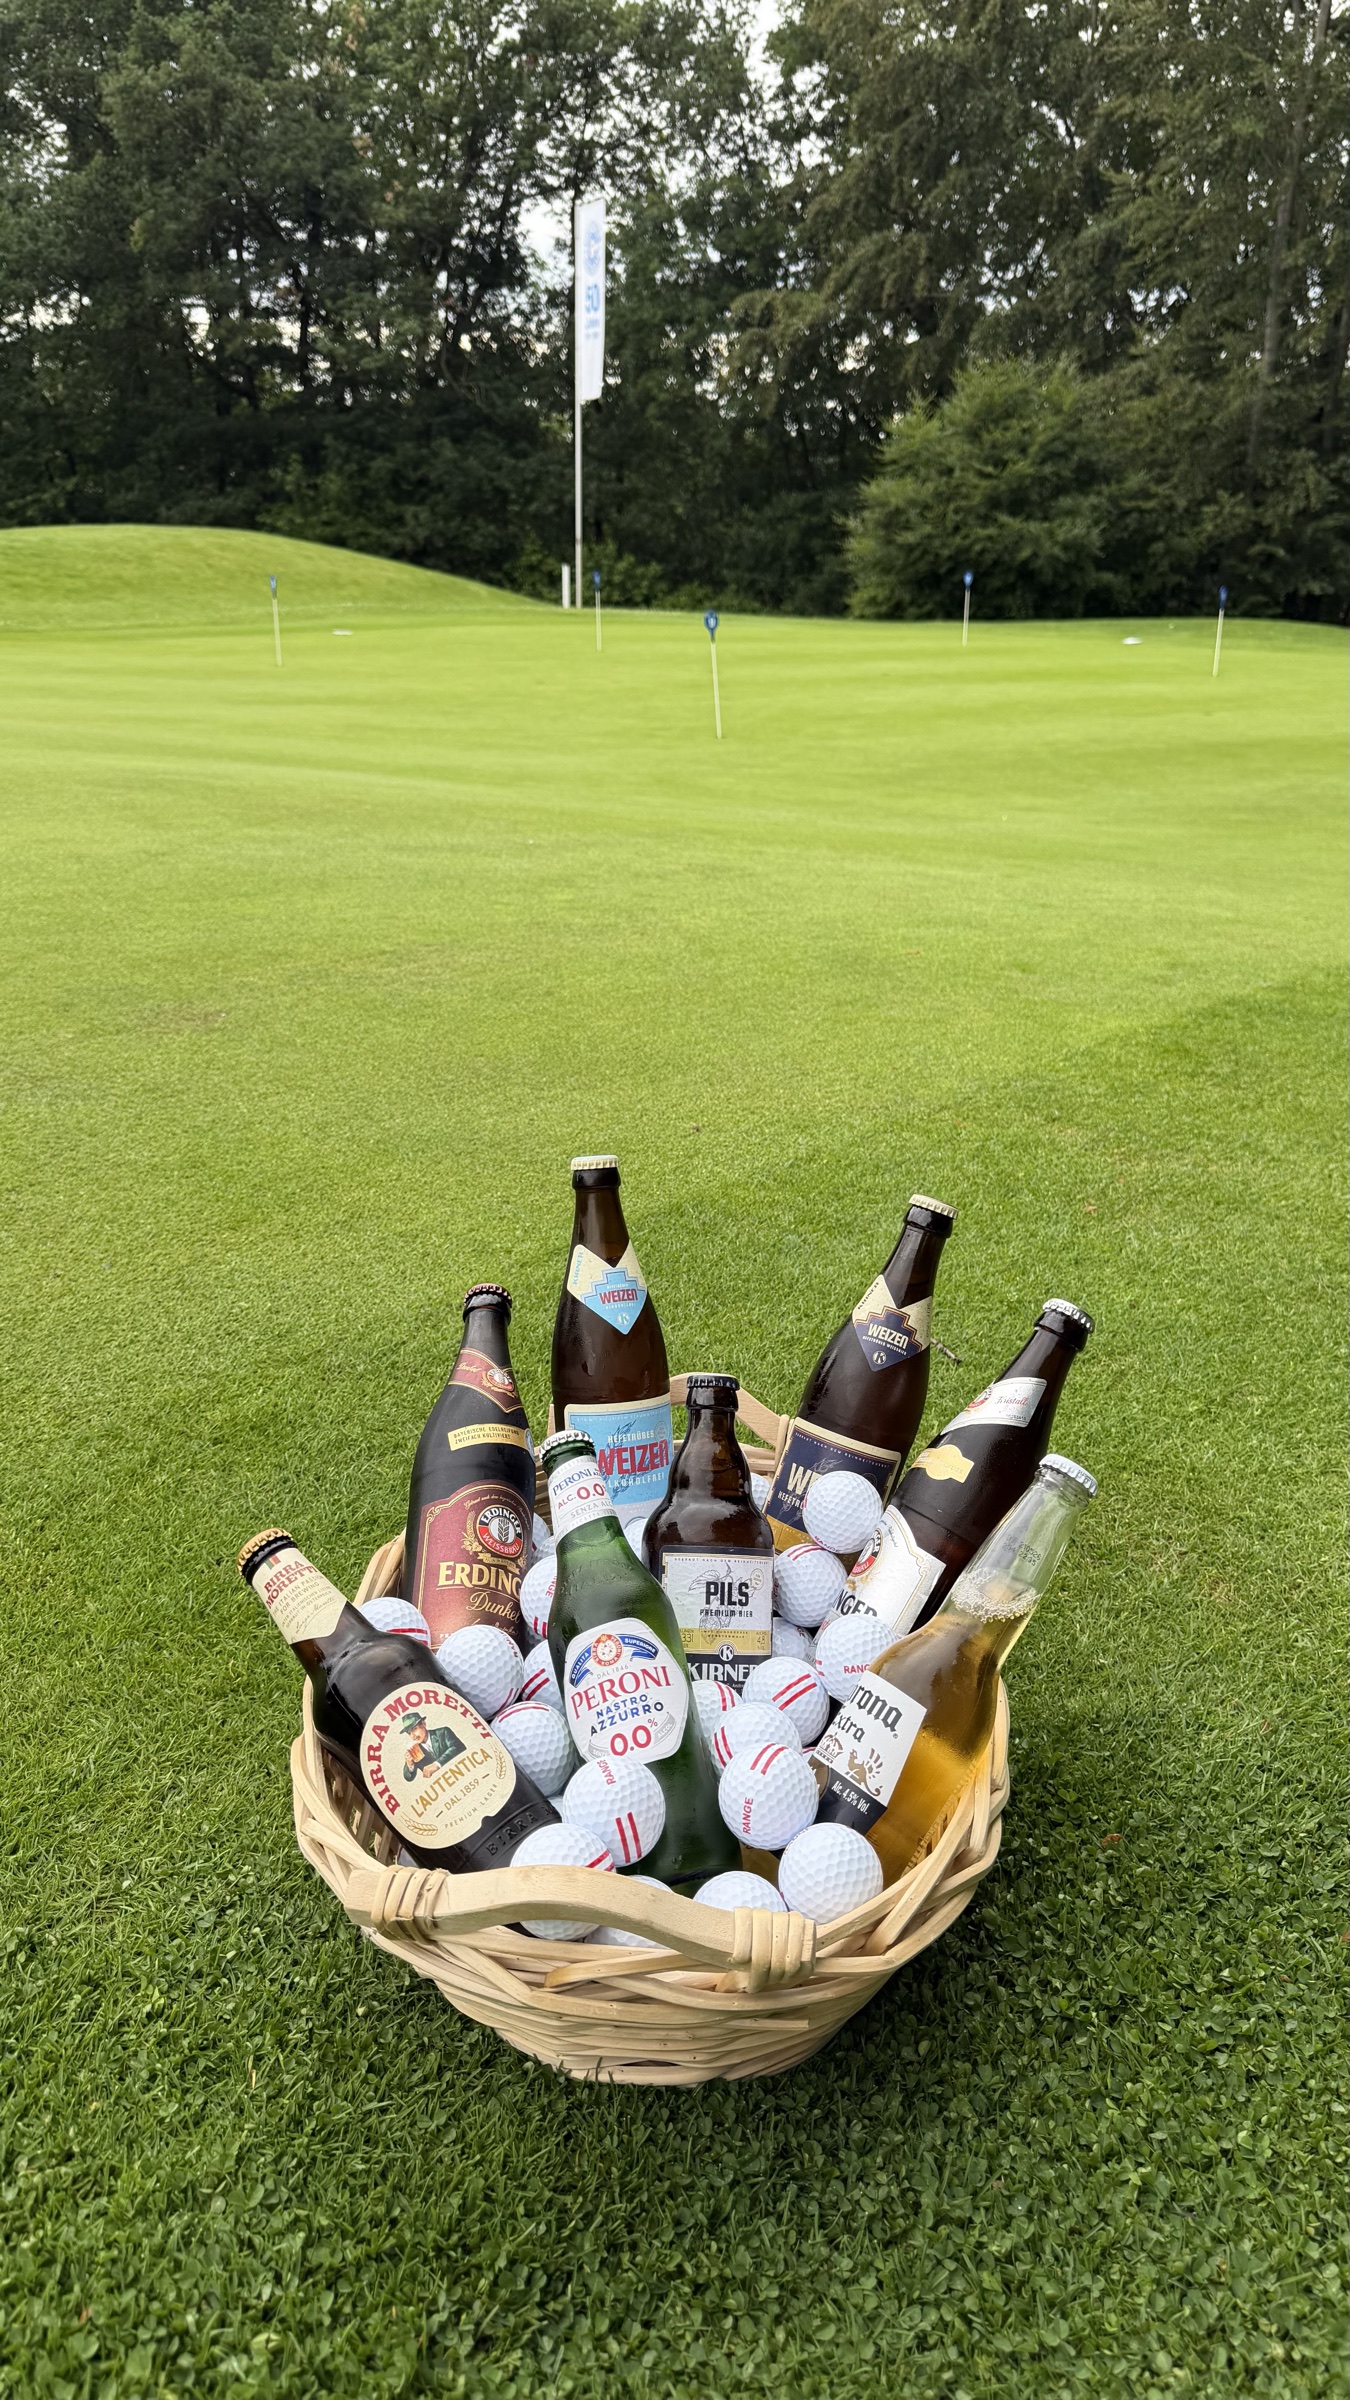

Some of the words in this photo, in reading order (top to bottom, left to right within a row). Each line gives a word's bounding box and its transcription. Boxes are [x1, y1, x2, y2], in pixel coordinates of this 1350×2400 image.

[599, 1288, 638, 1304] WEIZEN
[868, 1322, 909, 1350] WEIZEN
[608, 1430, 655, 1443] HEFETRÜBES
[597, 1438, 669, 1477] WEIZEN
[552, 1468, 592, 1496] PERONI
[608, 1472, 665, 1488] LKOHOLFREI
[557, 1494, 577, 1509] ALC.
[570, 1502, 599, 1519] SENZA
[481, 1508, 522, 1535] ERDINGER
[264, 1560, 304, 1593] BIRRA
[266, 1565, 318, 1609] MORETTI
[438, 1561, 522, 1600] ERDING
[279, 1584, 300, 1606] ITALIAN
[280, 1602, 291, 1615] FOR
[291, 1582, 320, 1602] BREWING
[466, 1591, 520, 1623] Dunkel
[705, 1581, 750, 1607] PILS
[700, 1608, 736, 1618] PREMIUM
[624, 1637, 656, 1653] SUPERIORE
[597, 1671, 610, 1680] DAL
[612, 1664, 629, 1673] 1846
[843, 1664, 871, 1674] RAN
[570, 1666, 672, 1720] PERONI
[596, 1694, 648, 1719] NASTRO
[383, 1689, 493, 1740] MORETTI
[590, 1701, 664, 1737] AZZURRO
[657, 1722, 673, 1738] ALCOL
[367, 1724, 401, 1816] BIRRA
[410, 1748, 493, 1818] L'AUTENTICA
[443, 1795, 462, 1812] DAL
[461, 1778, 480, 1798] 1859
[444, 1806, 478, 1829] PREMIUM
[481, 1783, 498, 1806] LAGER
[831, 1780, 843, 1796] Alc.
[842, 1788, 859, 1807] 4.5%
[857, 1797, 870, 1815] Vol.
[742, 1797, 753, 1835] RANGE
[486, 1812, 538, 1856] BIRRA
